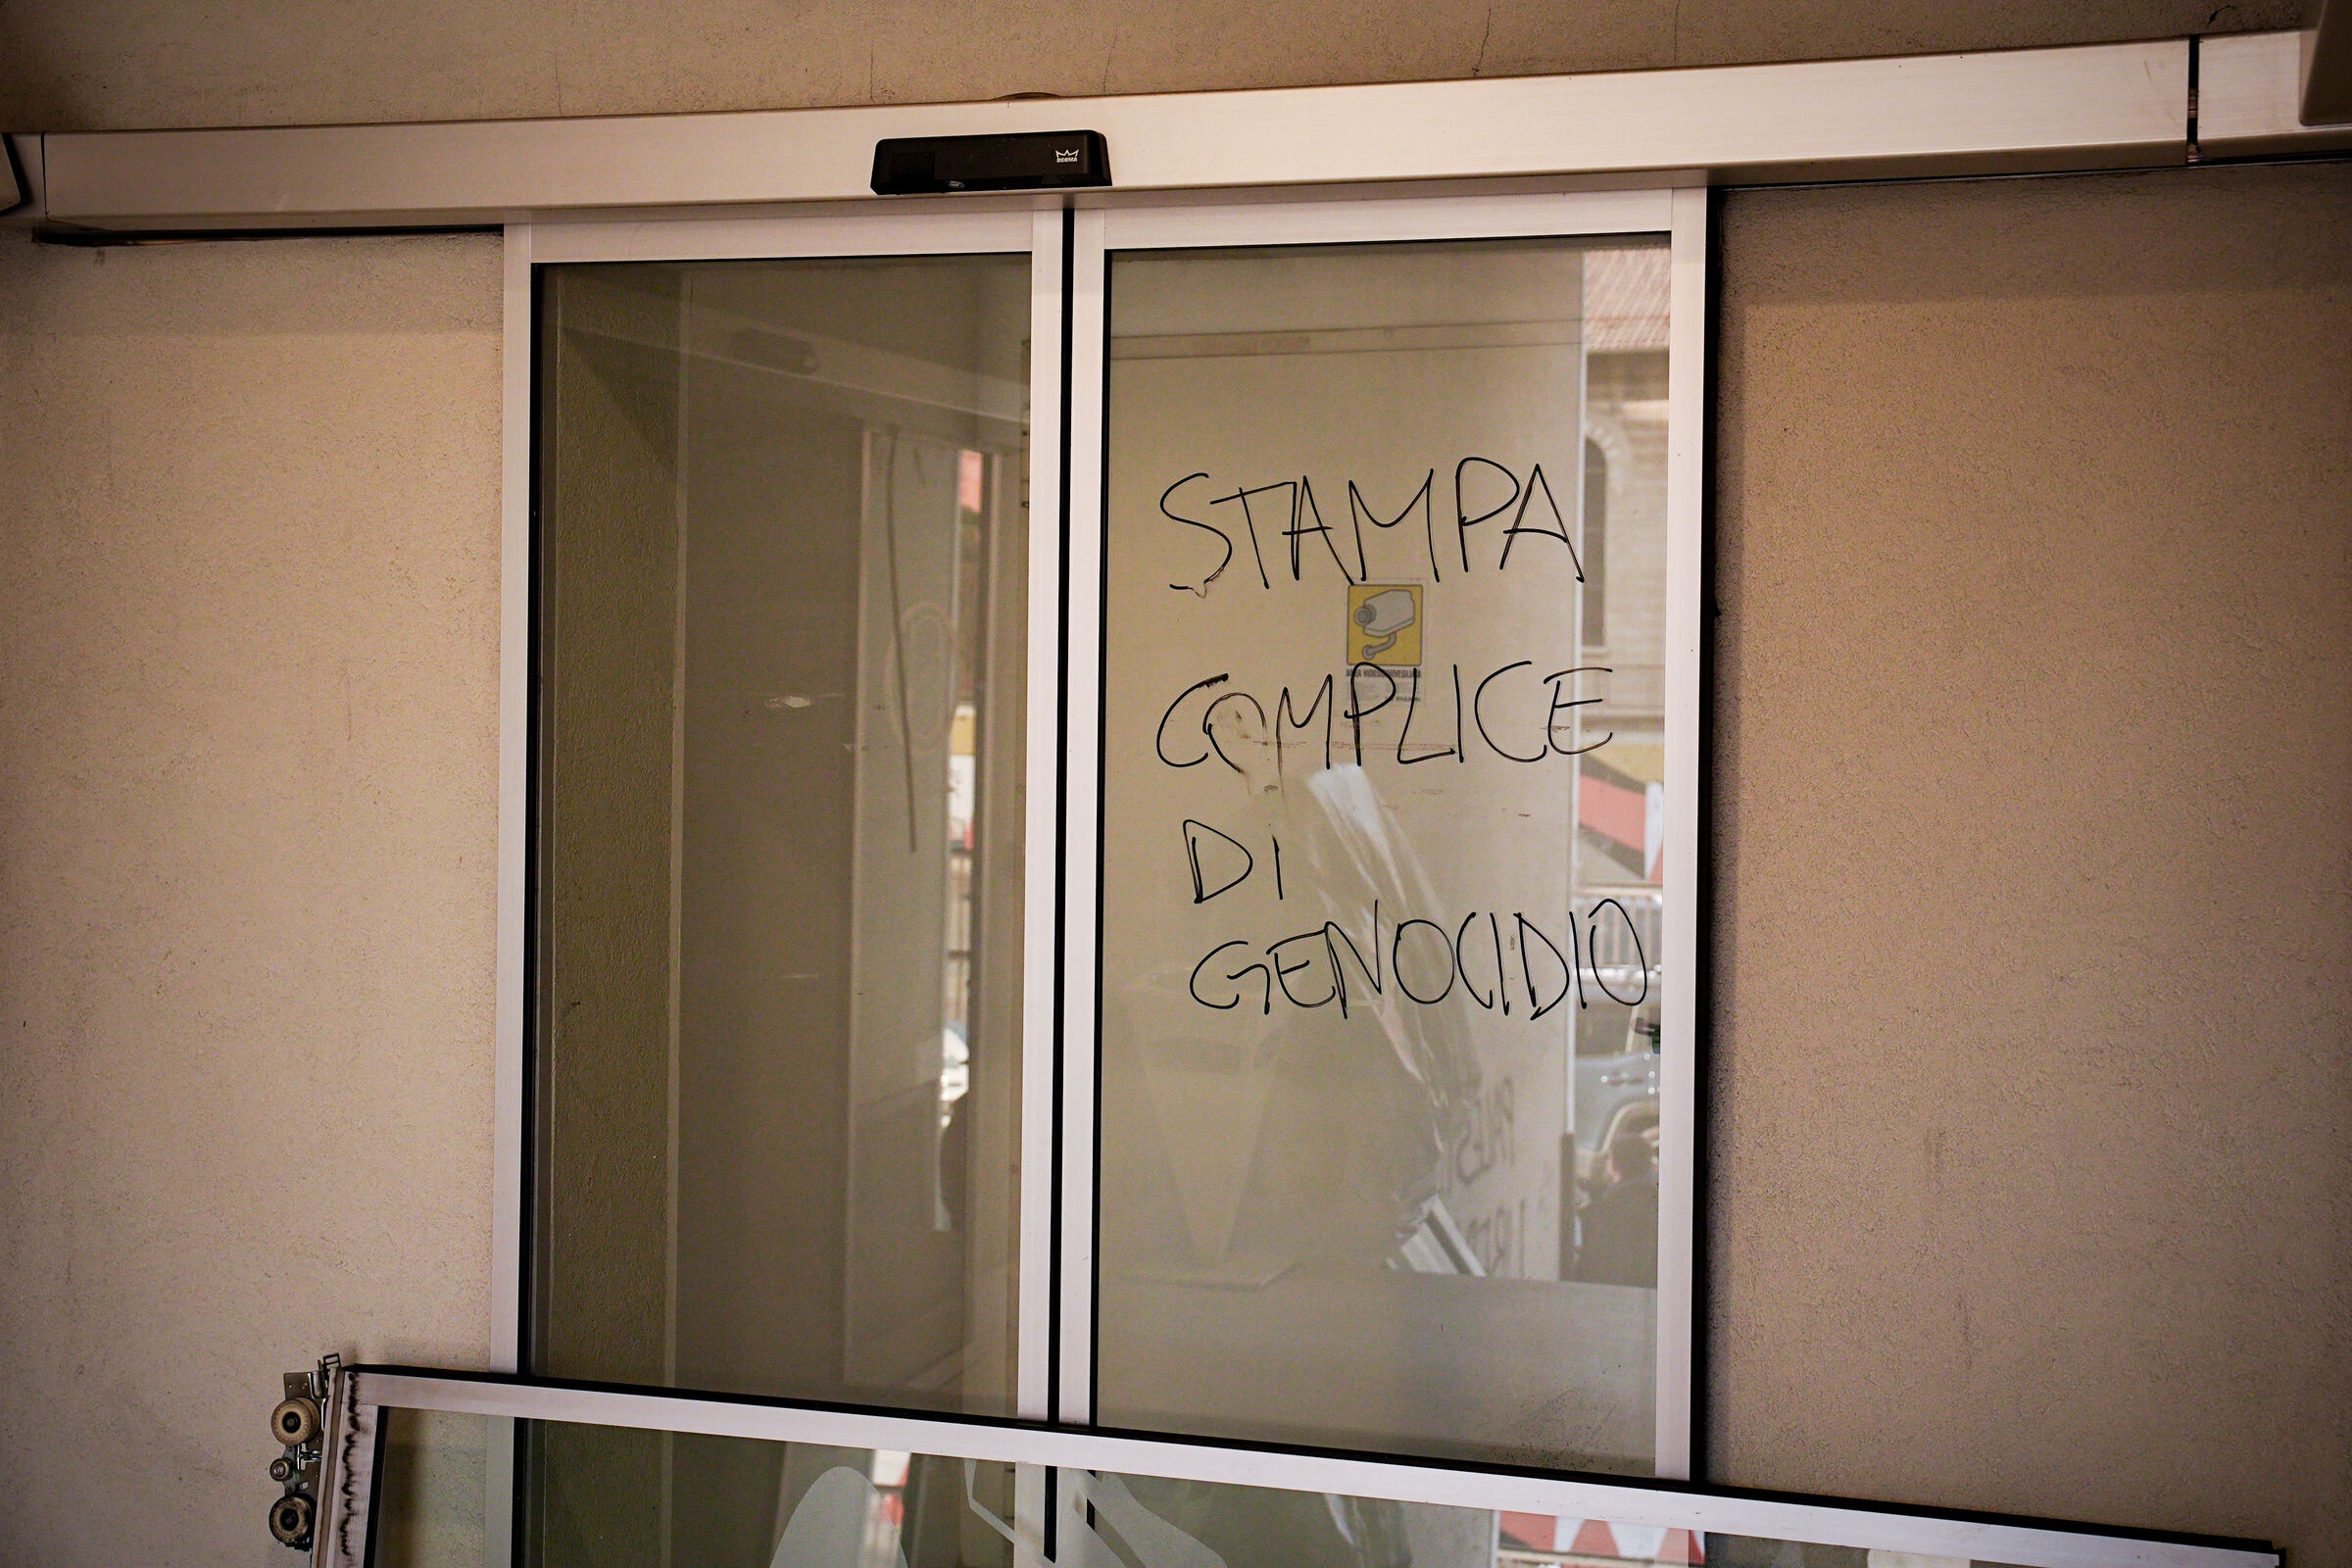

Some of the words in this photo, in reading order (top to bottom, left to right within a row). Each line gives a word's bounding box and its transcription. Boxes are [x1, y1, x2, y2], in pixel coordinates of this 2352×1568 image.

[1159, 458, 1586, 596] STAMPA
[1156, 662, 1614, 773] COMPLICE
[1183, 819, 1285, 904] DI
[1189, 899, 1648, 1021] GENOCIDIO
